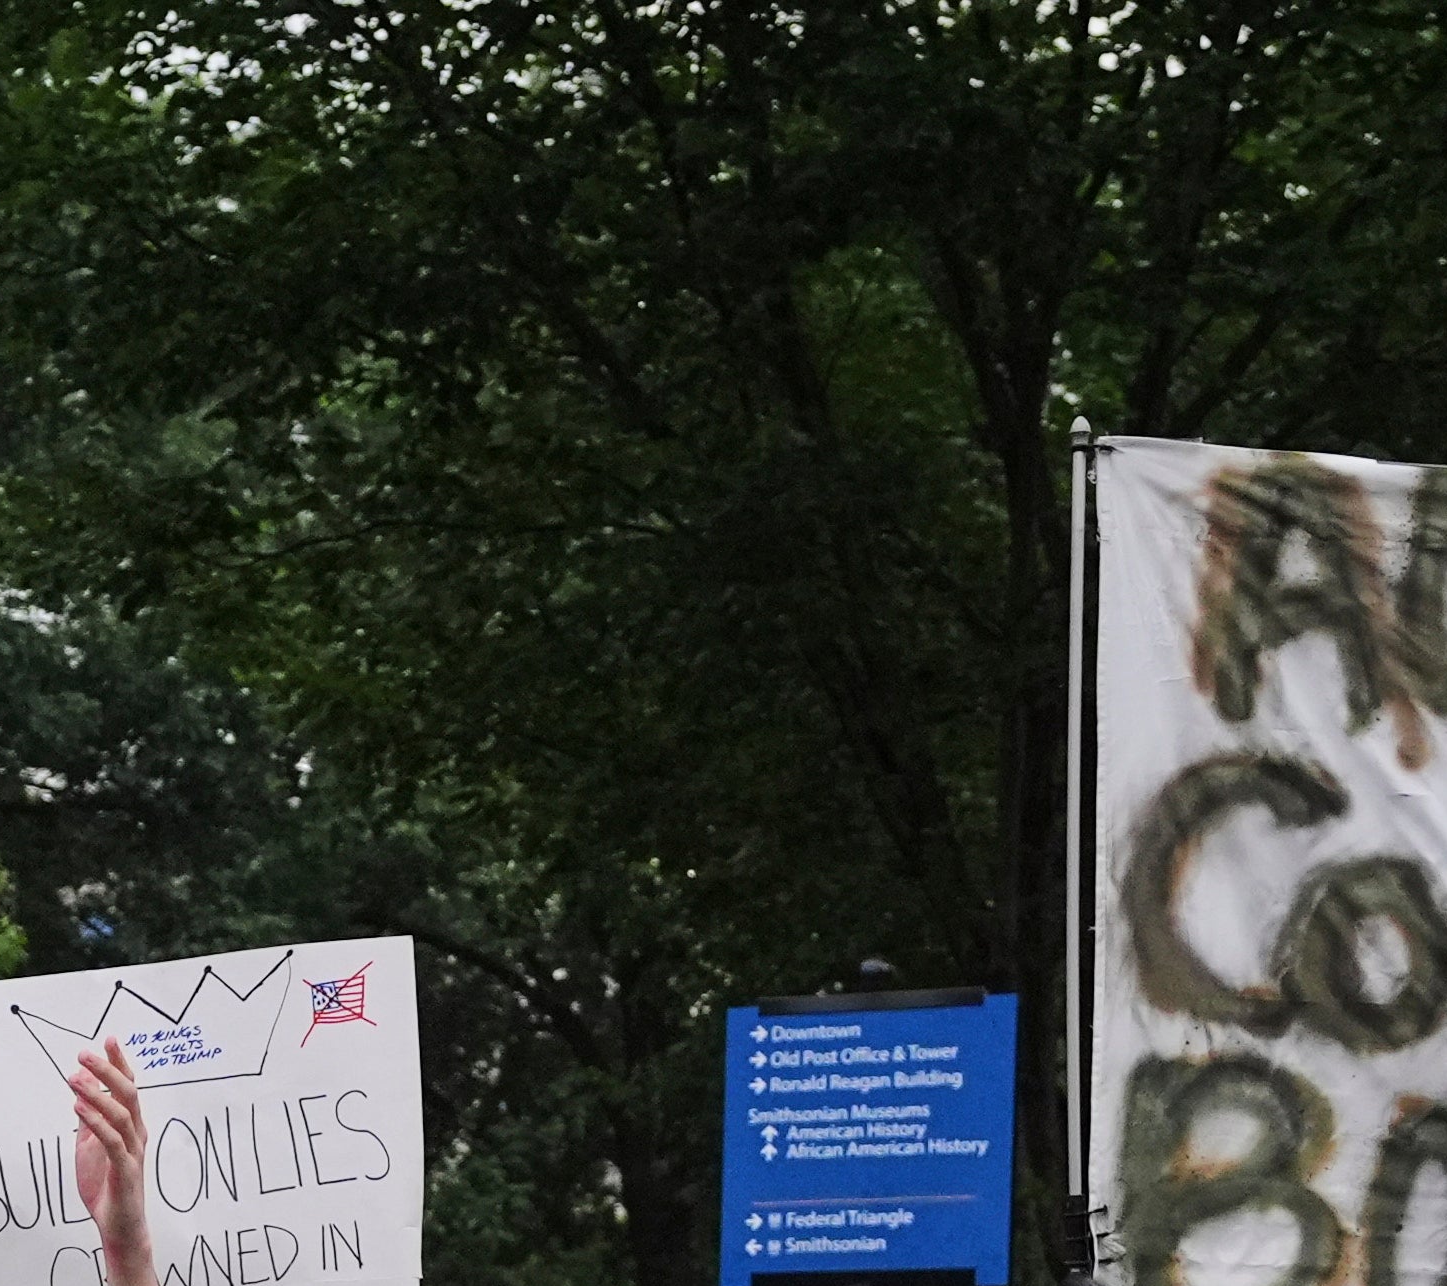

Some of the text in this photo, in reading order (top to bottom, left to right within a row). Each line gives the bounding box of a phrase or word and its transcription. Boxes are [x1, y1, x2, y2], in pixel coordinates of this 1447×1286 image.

[125, 1025, 201, 1046] NO KINGS
[770, 1024, 861, 1042] Downtown
[136, 1039, 203, 1057] NO CULTS
[143, 1047, 222, 1070] NO TRUMP
[770, 1044, 959, 1067] Old Post Office & Tower
[769, 1069, 964, 1094] Ronald Reagan Building
[748, 1103, 931, 1124] Smithsonian Museums
[786, 1122, 928, 1140] American History
[155, 1107, 239, 1214] ON
[248, 1088, 391, 1196] LIES
[786, 1138, 990, 1159] African American History
[785, 1208, 915, 1230] Federal Triangle
[319, 1220, 363, 1272] IN
[784, 1235, 887, 1255] Smithsonian
